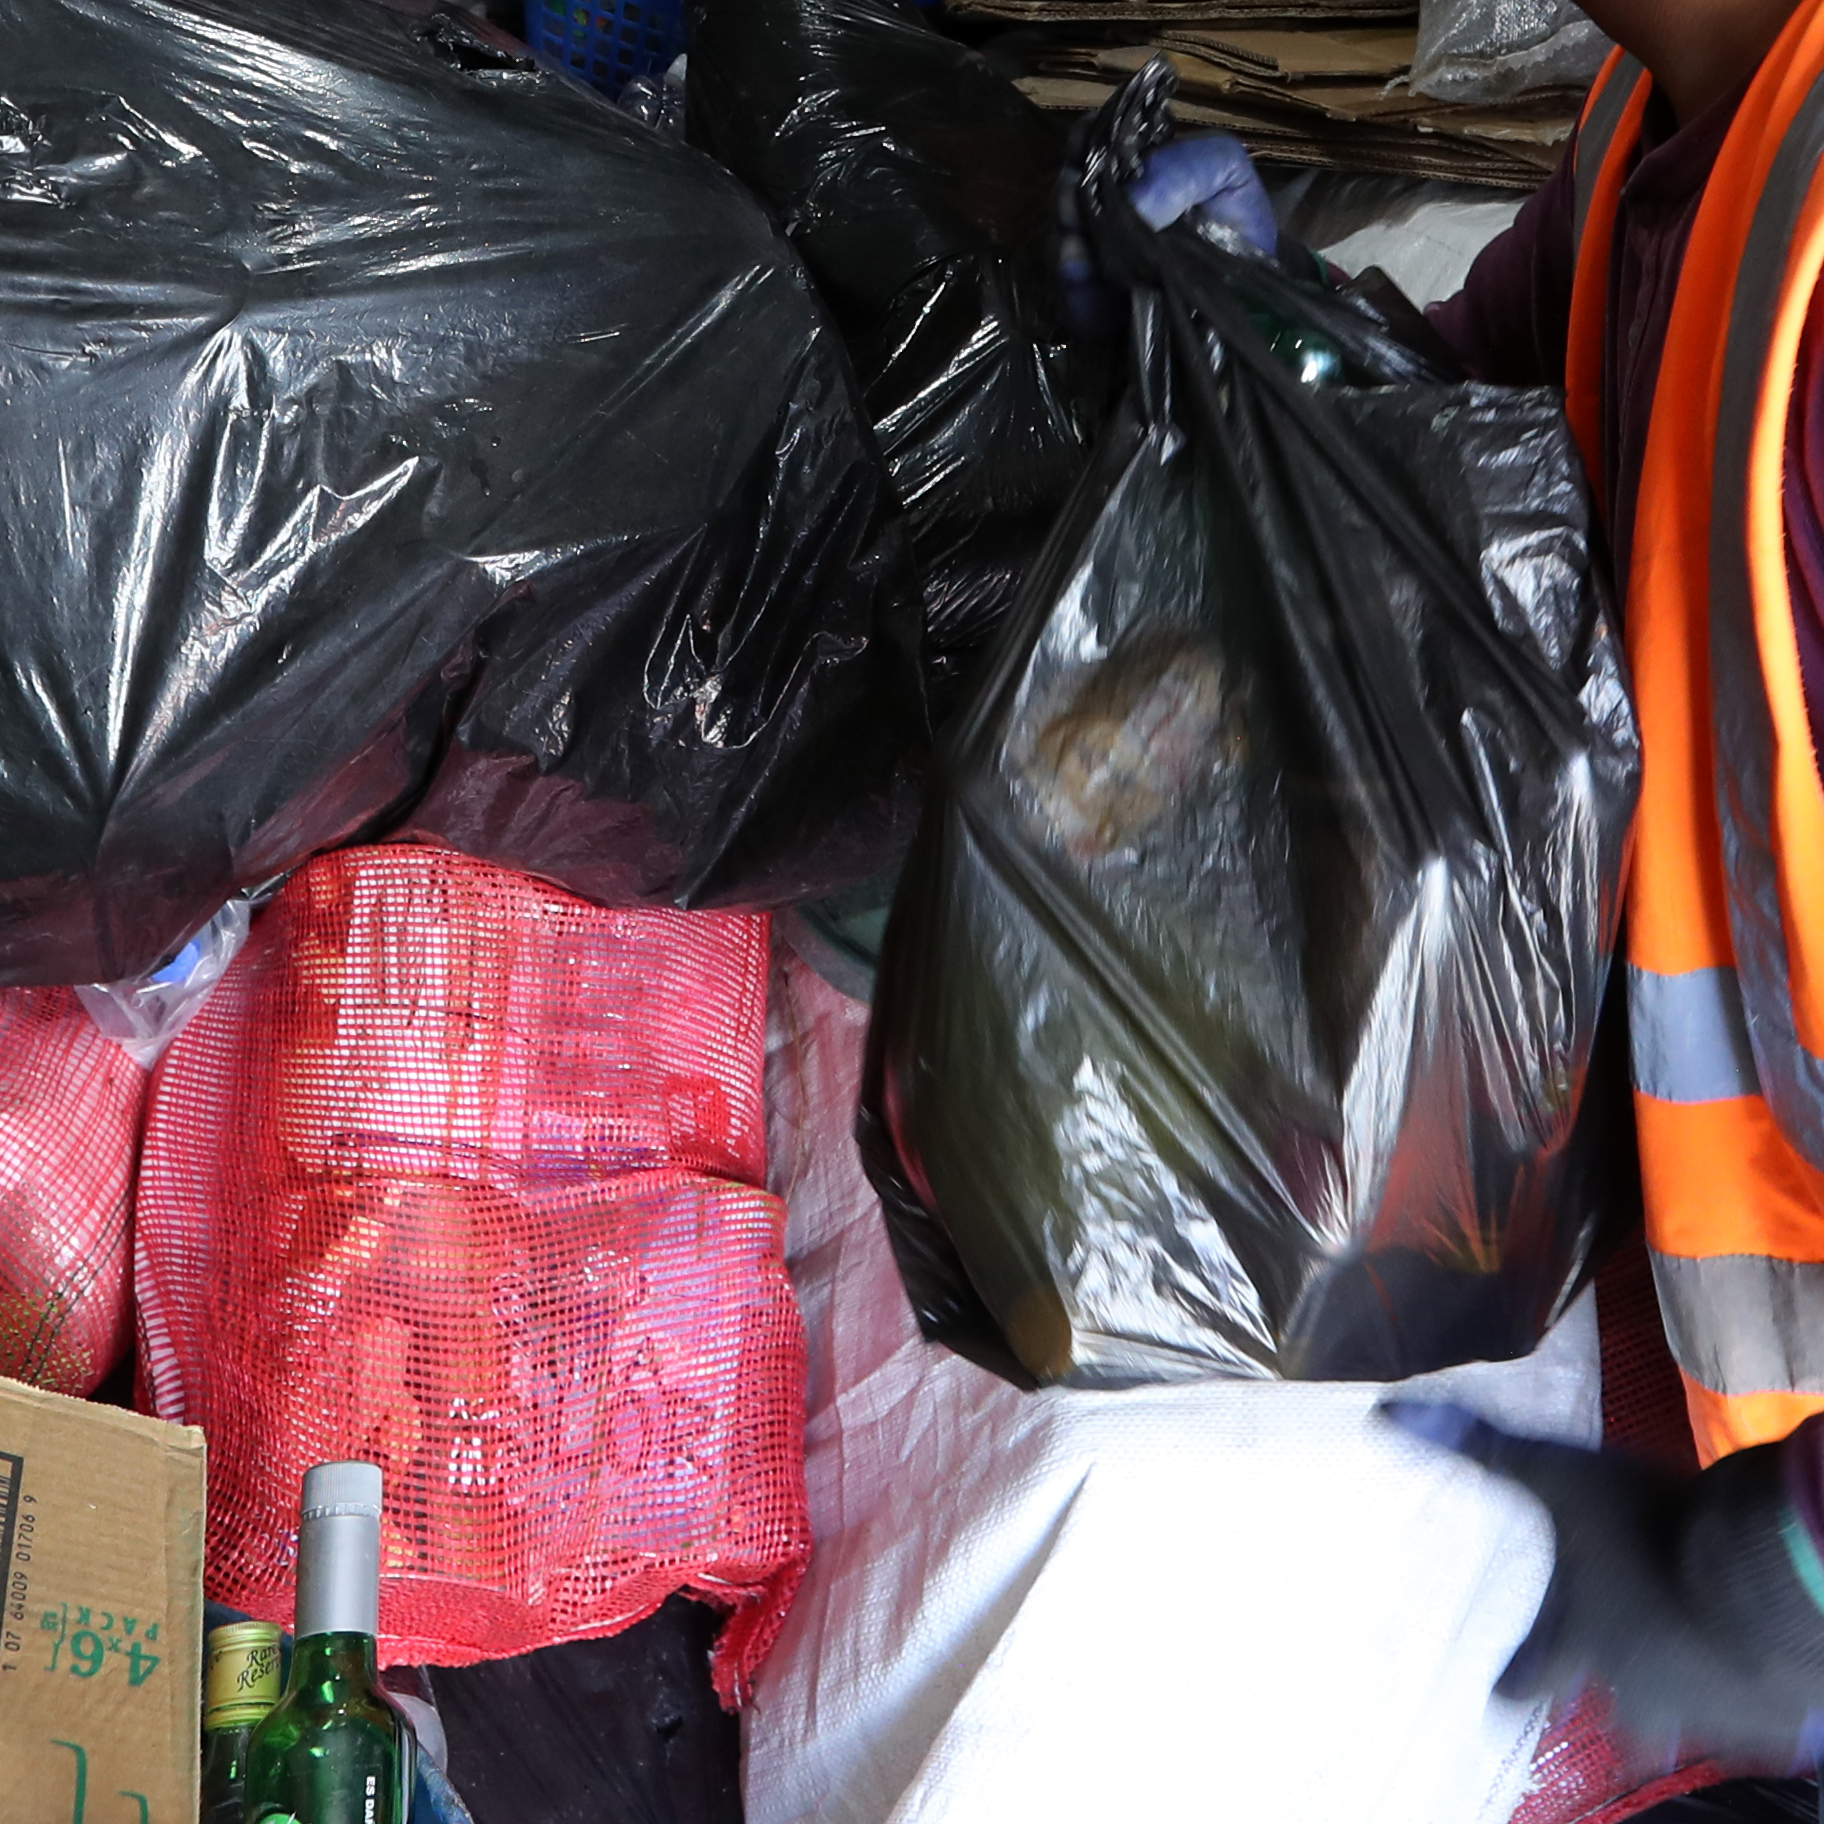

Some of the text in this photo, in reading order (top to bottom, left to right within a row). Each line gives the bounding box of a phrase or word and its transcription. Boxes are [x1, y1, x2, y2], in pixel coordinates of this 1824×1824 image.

[2, 1495, 38, 1672] 1 07 64009 01706 9
[76, 1605, 159, 1641] PACK
[365, 1775, 376, 1797] ES
